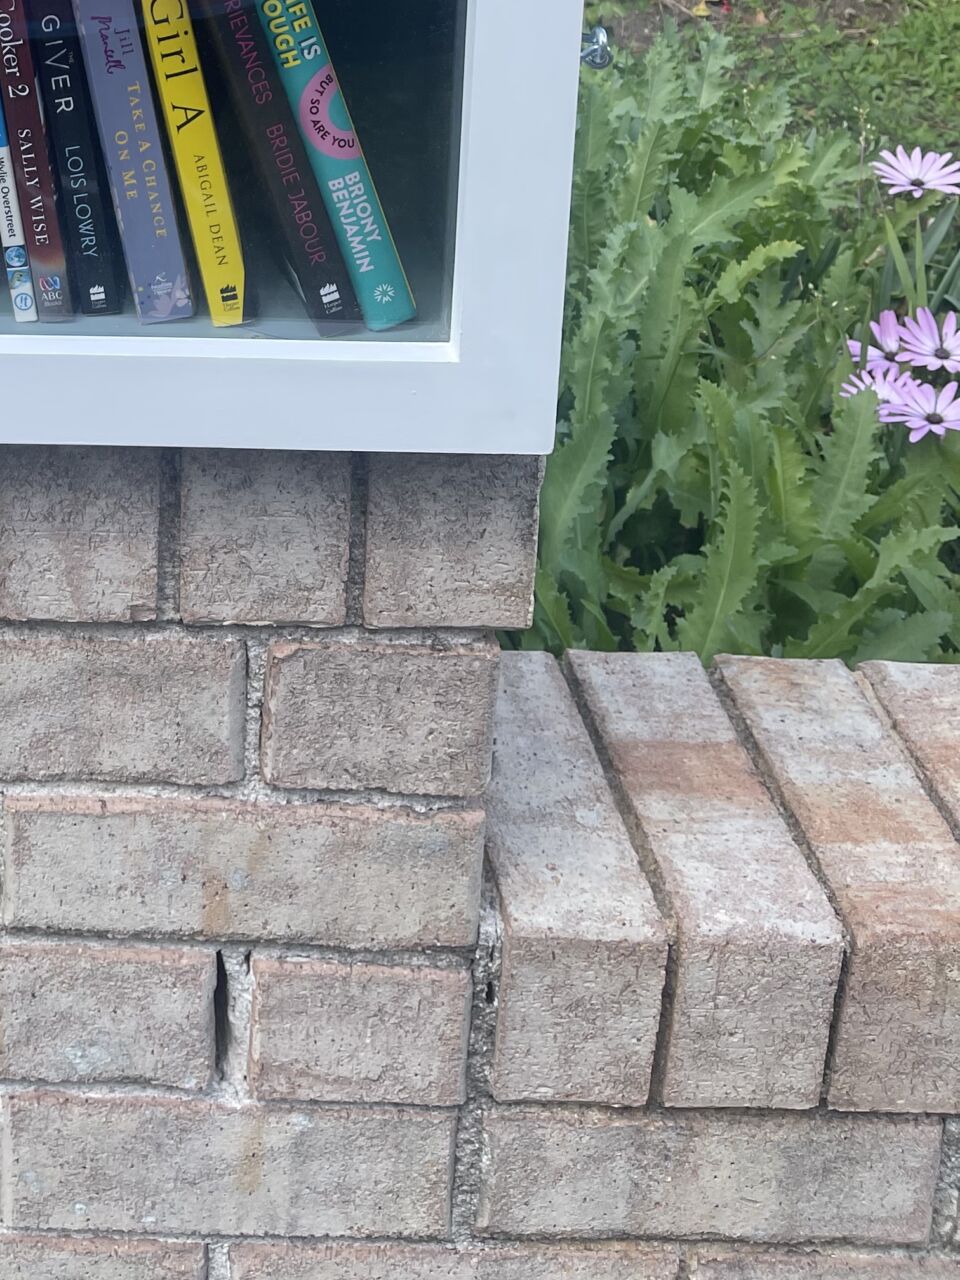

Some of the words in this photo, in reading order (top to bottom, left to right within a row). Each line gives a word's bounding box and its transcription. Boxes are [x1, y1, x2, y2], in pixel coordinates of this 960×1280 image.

[114, 27, 135, 56] Jill
[298, 36, 322, 61] IS
[41, 14, 74, 114] GIVER
[7, 83, 31, 99] 2
[315, 73, 334, 97] BUT
[127, 80, 148, 133] TAKE
[170, 100, 207, 134] A
[309, 98, 321, 115] SO
[114, 130, 131, 156] ON
[137, 140, 152, 152] A
[310, 119, 331, 141] ARE
[331, 135, 355, 148] YOU
[17, 127, 42, 190] SALLY
[64, 145, 87, 190] LOIS
[121, 166, 138, 200] ME
[142, 157, 168, 238] CHANCE
[265, 122, 300, 186] BRIDIE
[287, 185, 328, 266] JABOUR
[27, 190, 50, 247] WISE
[193, 153, 223, 221] ABIGAIL
[208, 224, 229, 267] DEAN
[344, 171, 382, 244] BRIONY
[72, 192, 99, 258] LOWRY
[327, 177, 376, 273] BENJAMIN
[41, 290, 63, 300] ABC
